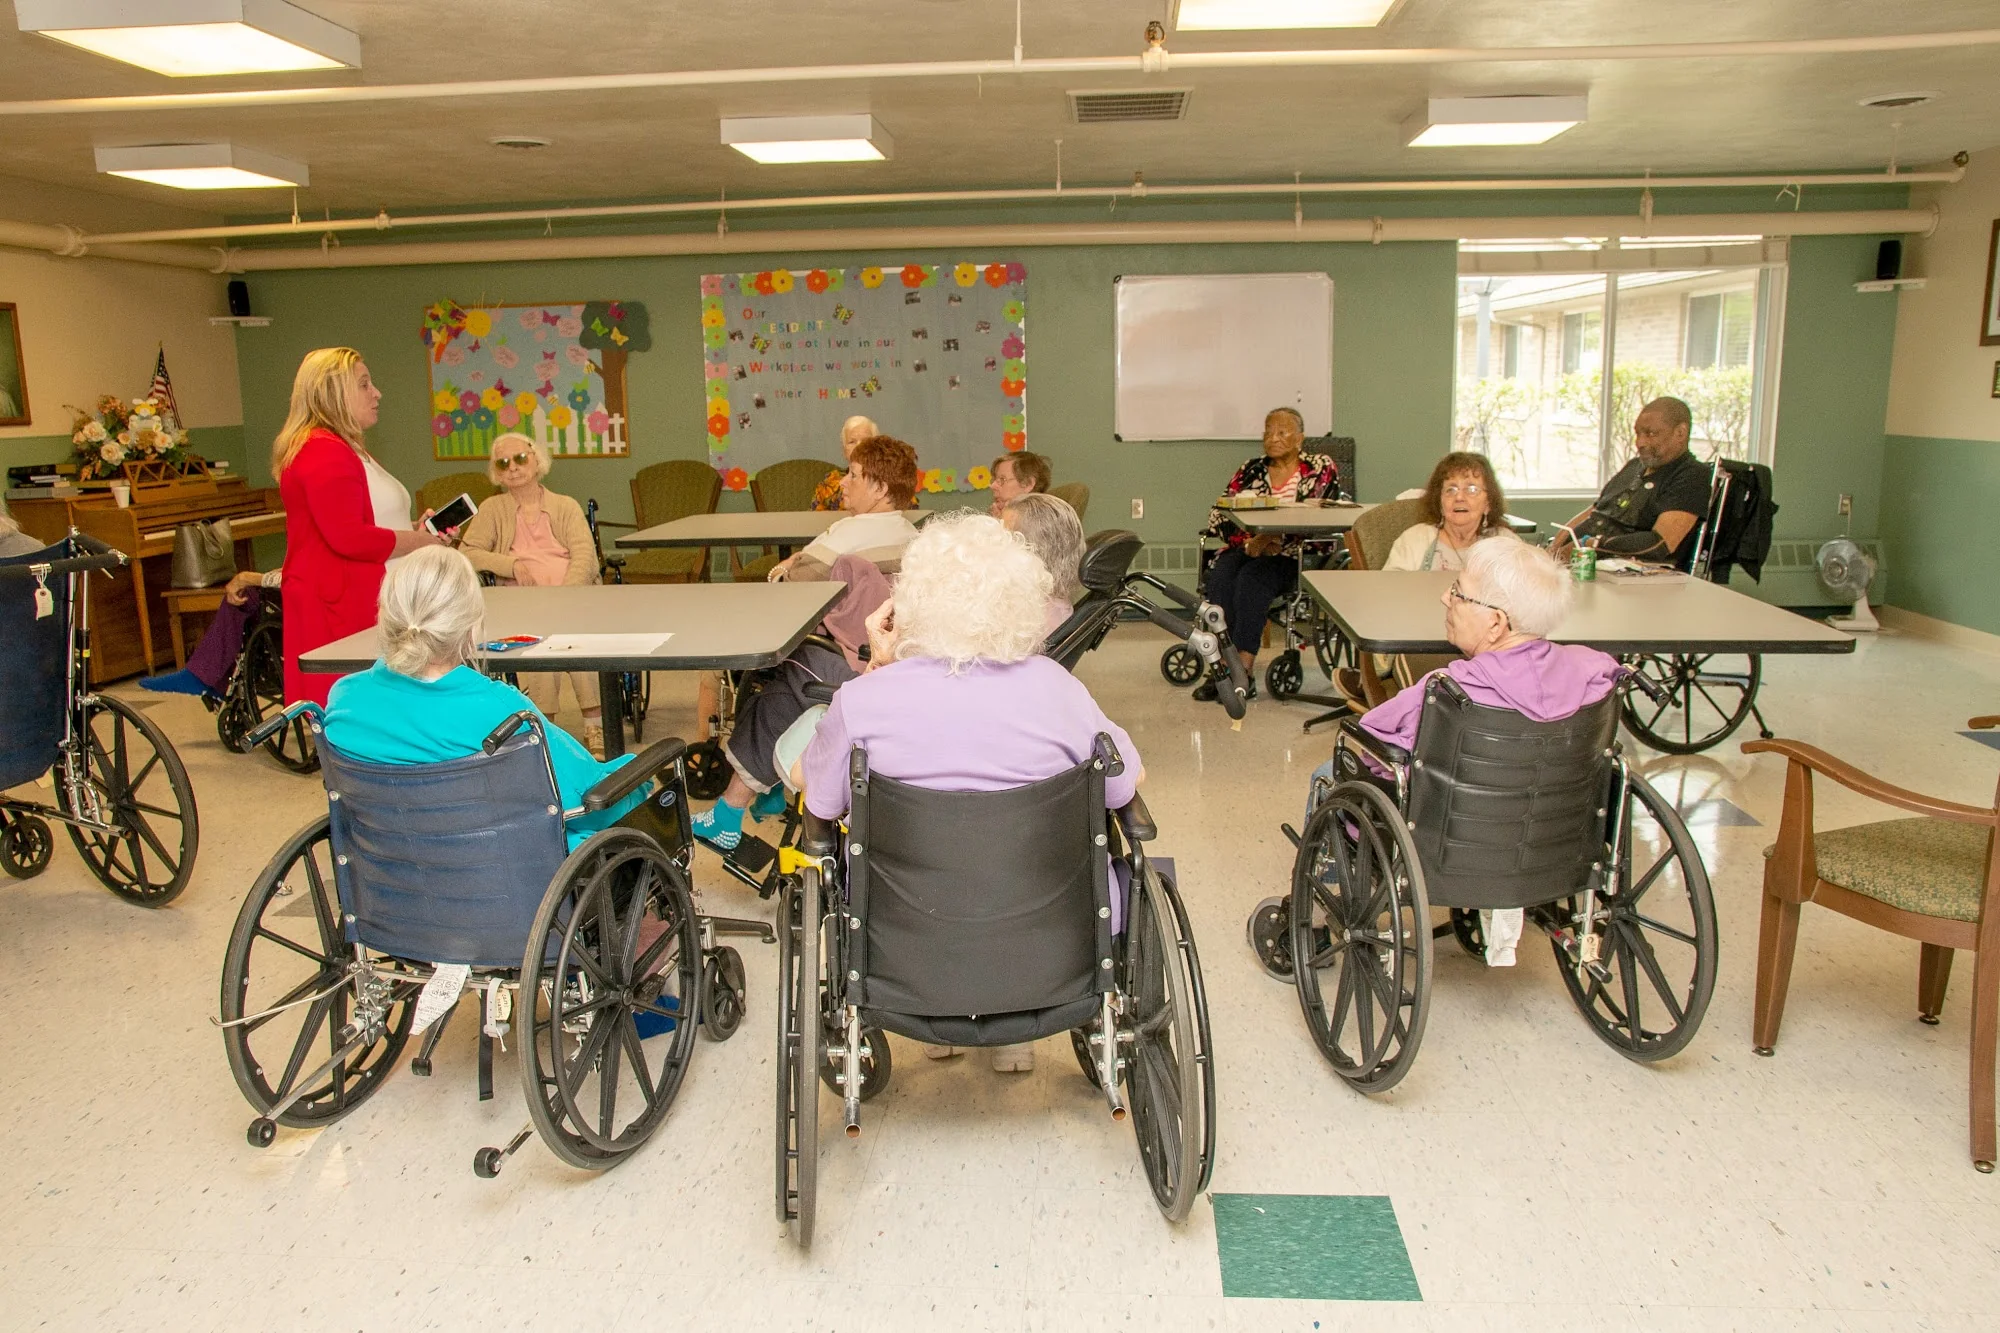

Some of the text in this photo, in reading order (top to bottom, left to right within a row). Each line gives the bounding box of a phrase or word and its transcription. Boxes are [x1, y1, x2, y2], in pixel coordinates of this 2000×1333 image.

[742, 308, 765, 320] Our
[859, 337, 870, 347] in
[876, 338, 895, 348] our
[825, 361, 841, 370] we
[889, 357, 902, 368] in
[818, 388, 857, 399] HOME
